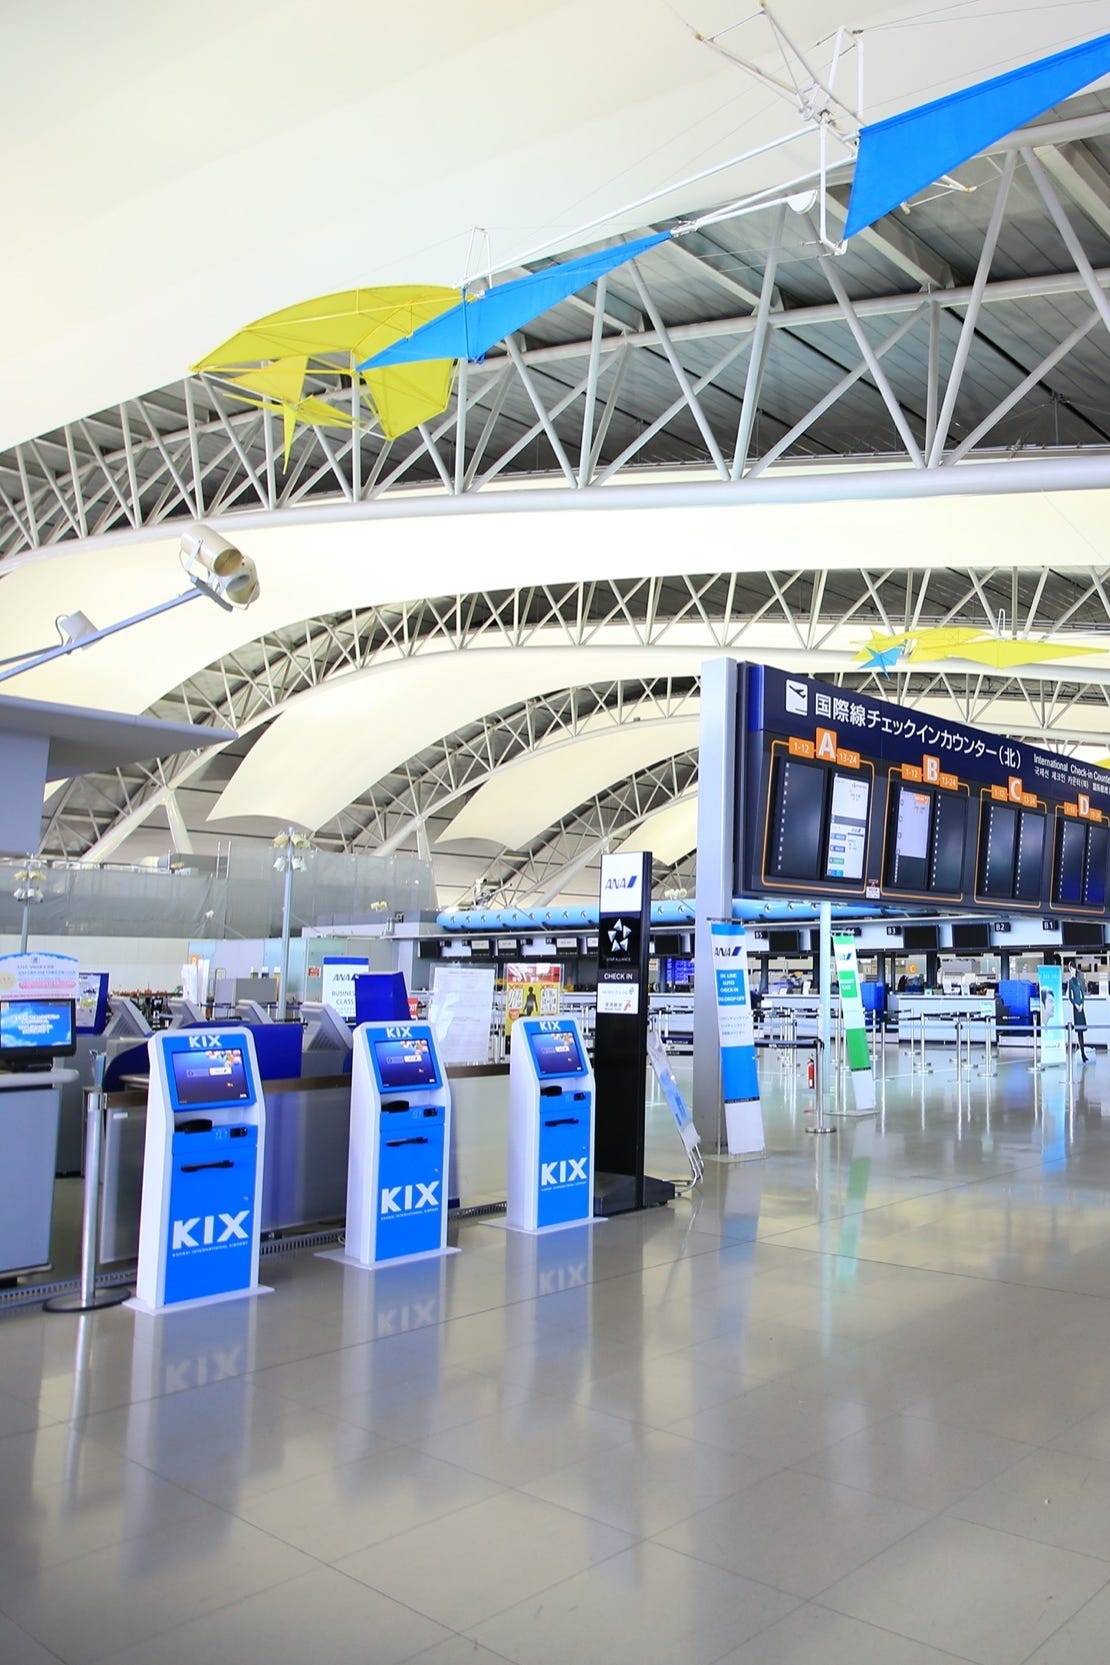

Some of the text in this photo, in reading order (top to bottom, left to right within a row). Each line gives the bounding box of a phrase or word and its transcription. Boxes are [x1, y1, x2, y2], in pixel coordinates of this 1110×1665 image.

[815, 692, 1022, 769] 国際線チェックインカウンター（北）
[793, 741, 810, 754] 1-12
[818, 732, 836, 760] A
[839, 751, 858, 764] 13-24
[905, 767, 919, 778] 1-12
[926, 758, 938, 781] B
[1033, 753, 1069, 772] International
[1070, 763, 1094, 780] Check-in
[941, 776, 956, 786] 13-24
[1010, 779, 1021, 800] C
[1079, 797, 1088, 816] D
[605, 877, 627, 891] ANA
[887, 927, 896, 935] B3
[995, 923, 1005, 931] B2
[1043, 921, 1053, 930] B1
[714, 946, 731, 957] ANA
[604, 972, 633, 980] CHECK IN
[386, 1026, 412, 1039] KIX
[540, 1020, 561, 1032] KIX
[188, 1035, 222, 1048] KIX
[541, 1157, 588, 1187] KIX
[381, 1181, 440, 1215] KIX
[172, 1210, 250, 1251] KIX
